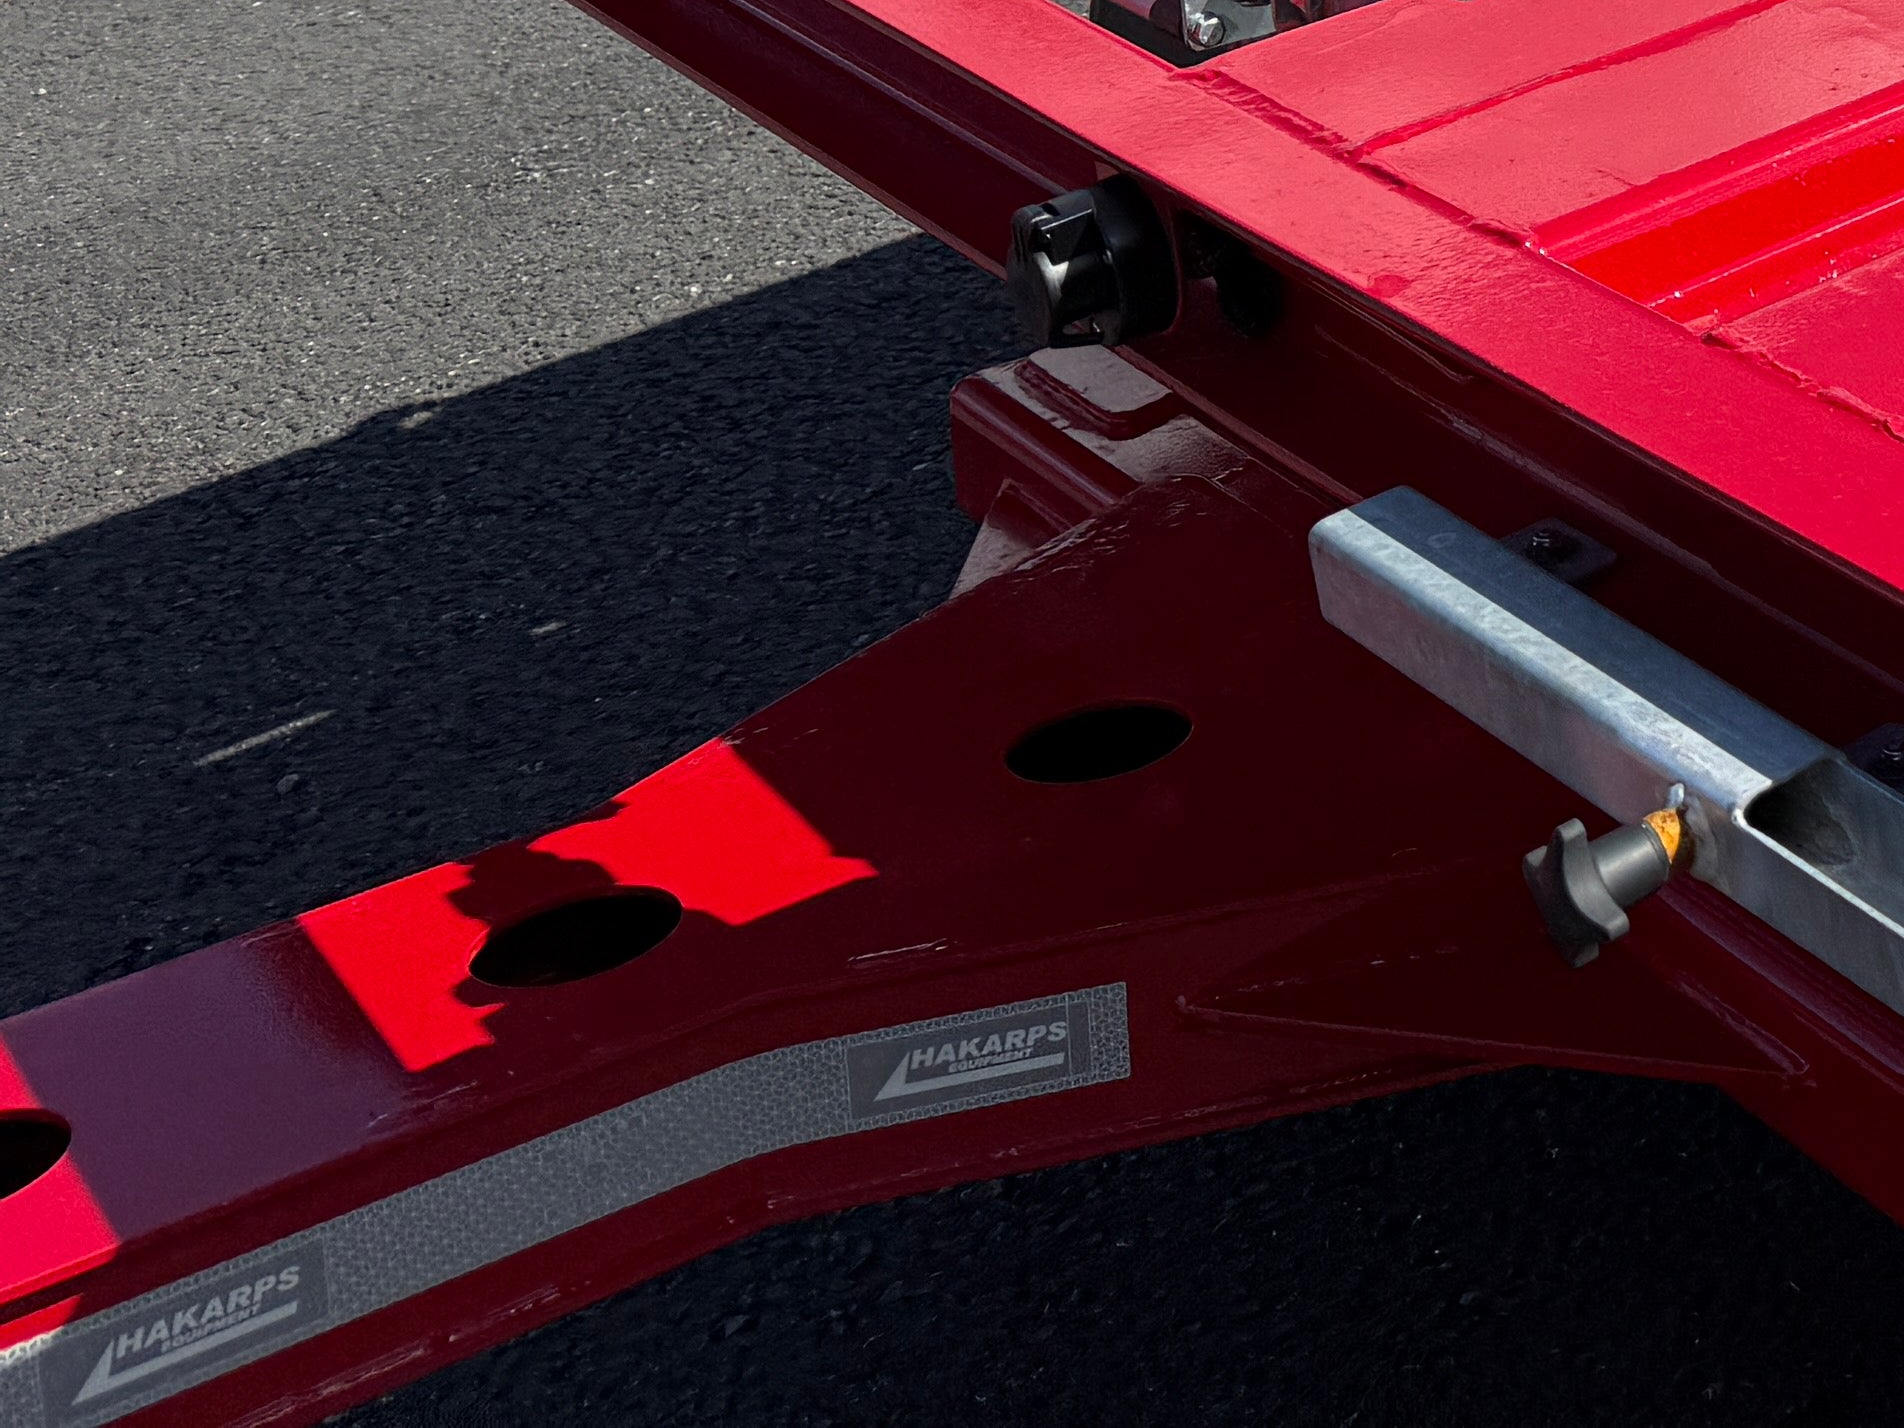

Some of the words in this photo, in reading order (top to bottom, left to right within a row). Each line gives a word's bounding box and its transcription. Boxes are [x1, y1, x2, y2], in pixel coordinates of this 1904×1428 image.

[910, 1020, 1068, 1070] HAKARPS
[948, 1047, 1036, 1073] EQUIPMENT
[115, 1265, 301, 1359] HAKARPS
[160, 1302, 262, 1354] EQUIPMENT
